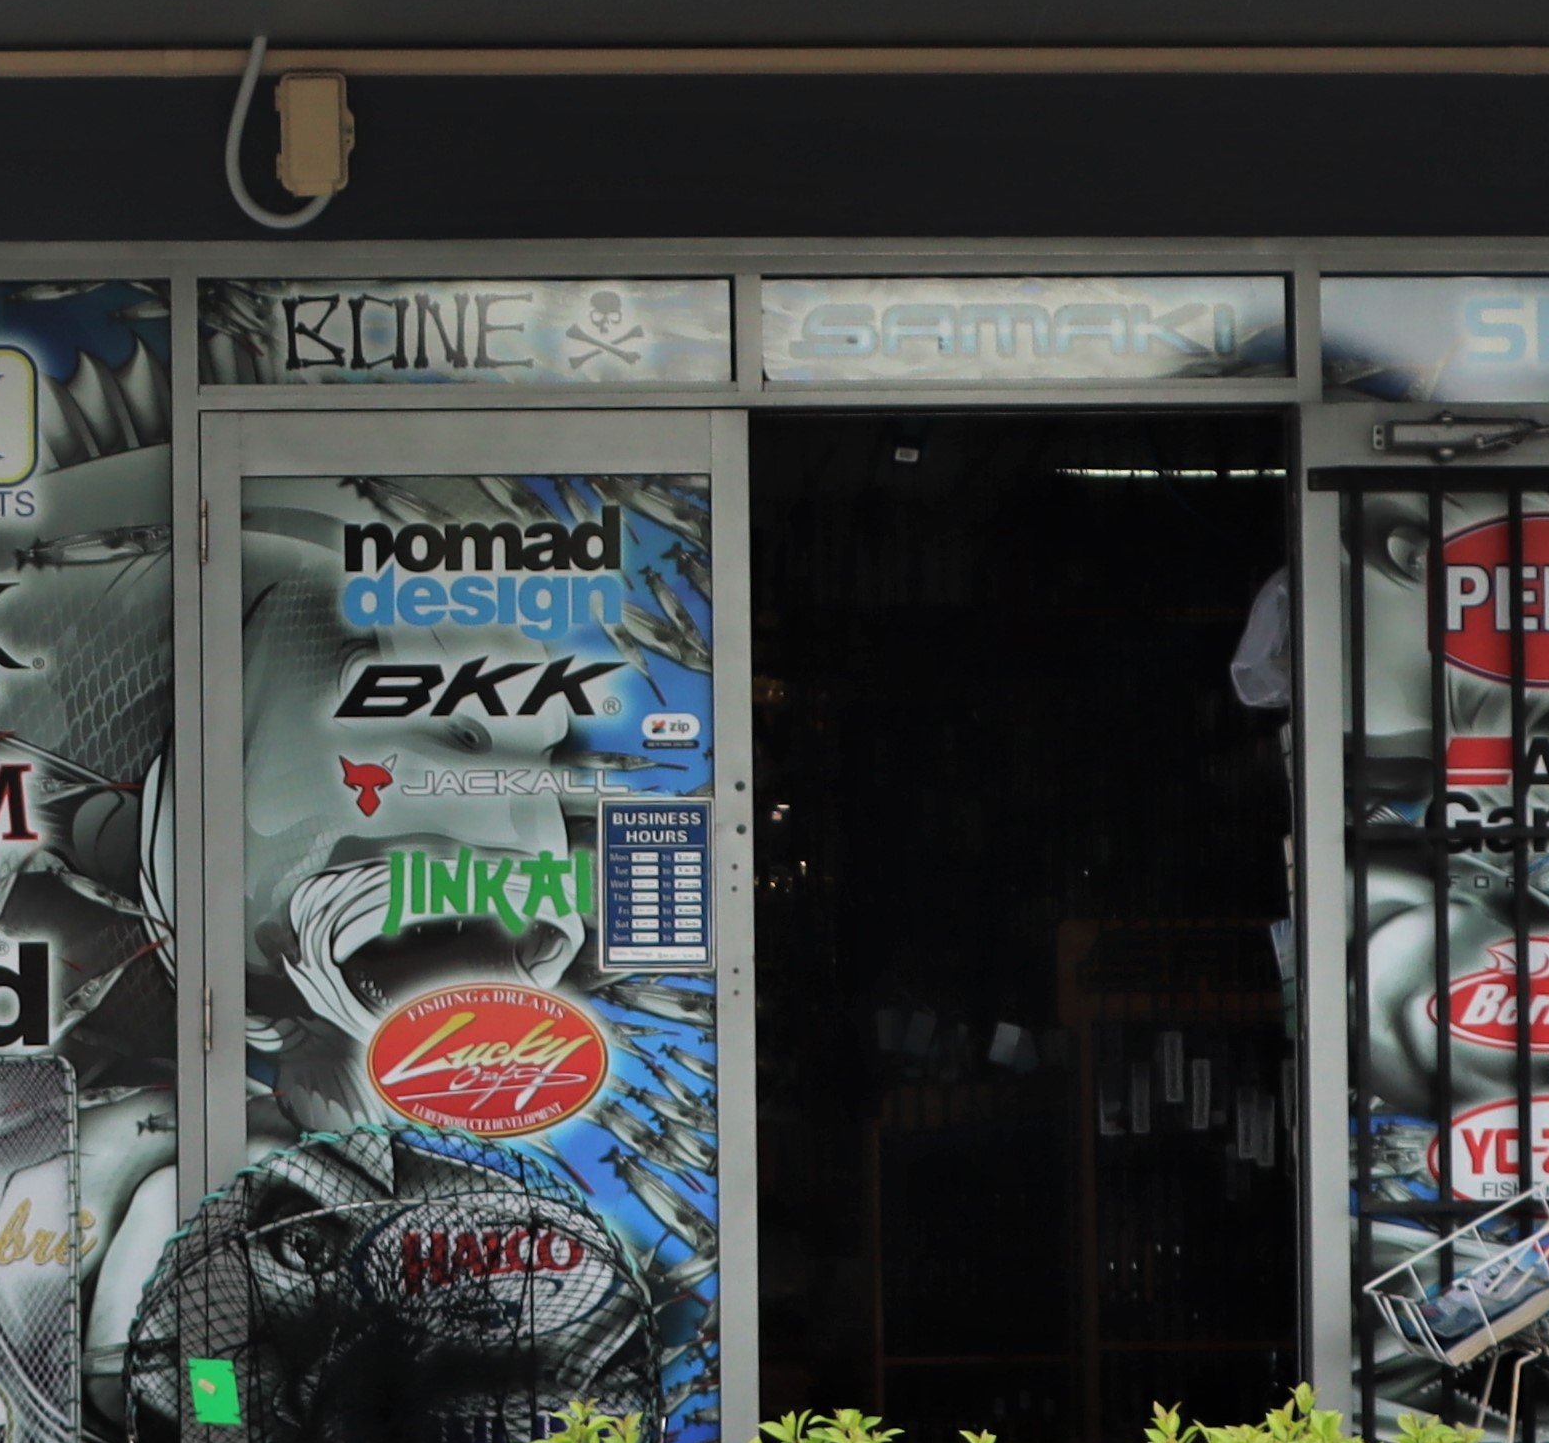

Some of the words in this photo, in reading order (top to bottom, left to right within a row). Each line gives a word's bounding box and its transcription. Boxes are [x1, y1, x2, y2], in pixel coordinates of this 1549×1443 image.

[281, 292, 534, 371] BONE
[789, 302, 1239, 356] SAMAKI
[343, 506, 623, 573] nomad
[342, 565, 624, 642] design
[333, 655, 629, 718] BKK
[669, 719, 690, 734] zip
[401, 767, 631, 797] JACKALL
[612, 811, 702, 826] BUSINESS
[625, 829, 689, 844] HOURS
[381, 846, 594, 936] JINKAI
[406, 990, 480, 1023] FISHING
[492, 990, 567, 1020] DREAMS
[379, 1011, 596, 1112] Lucky
